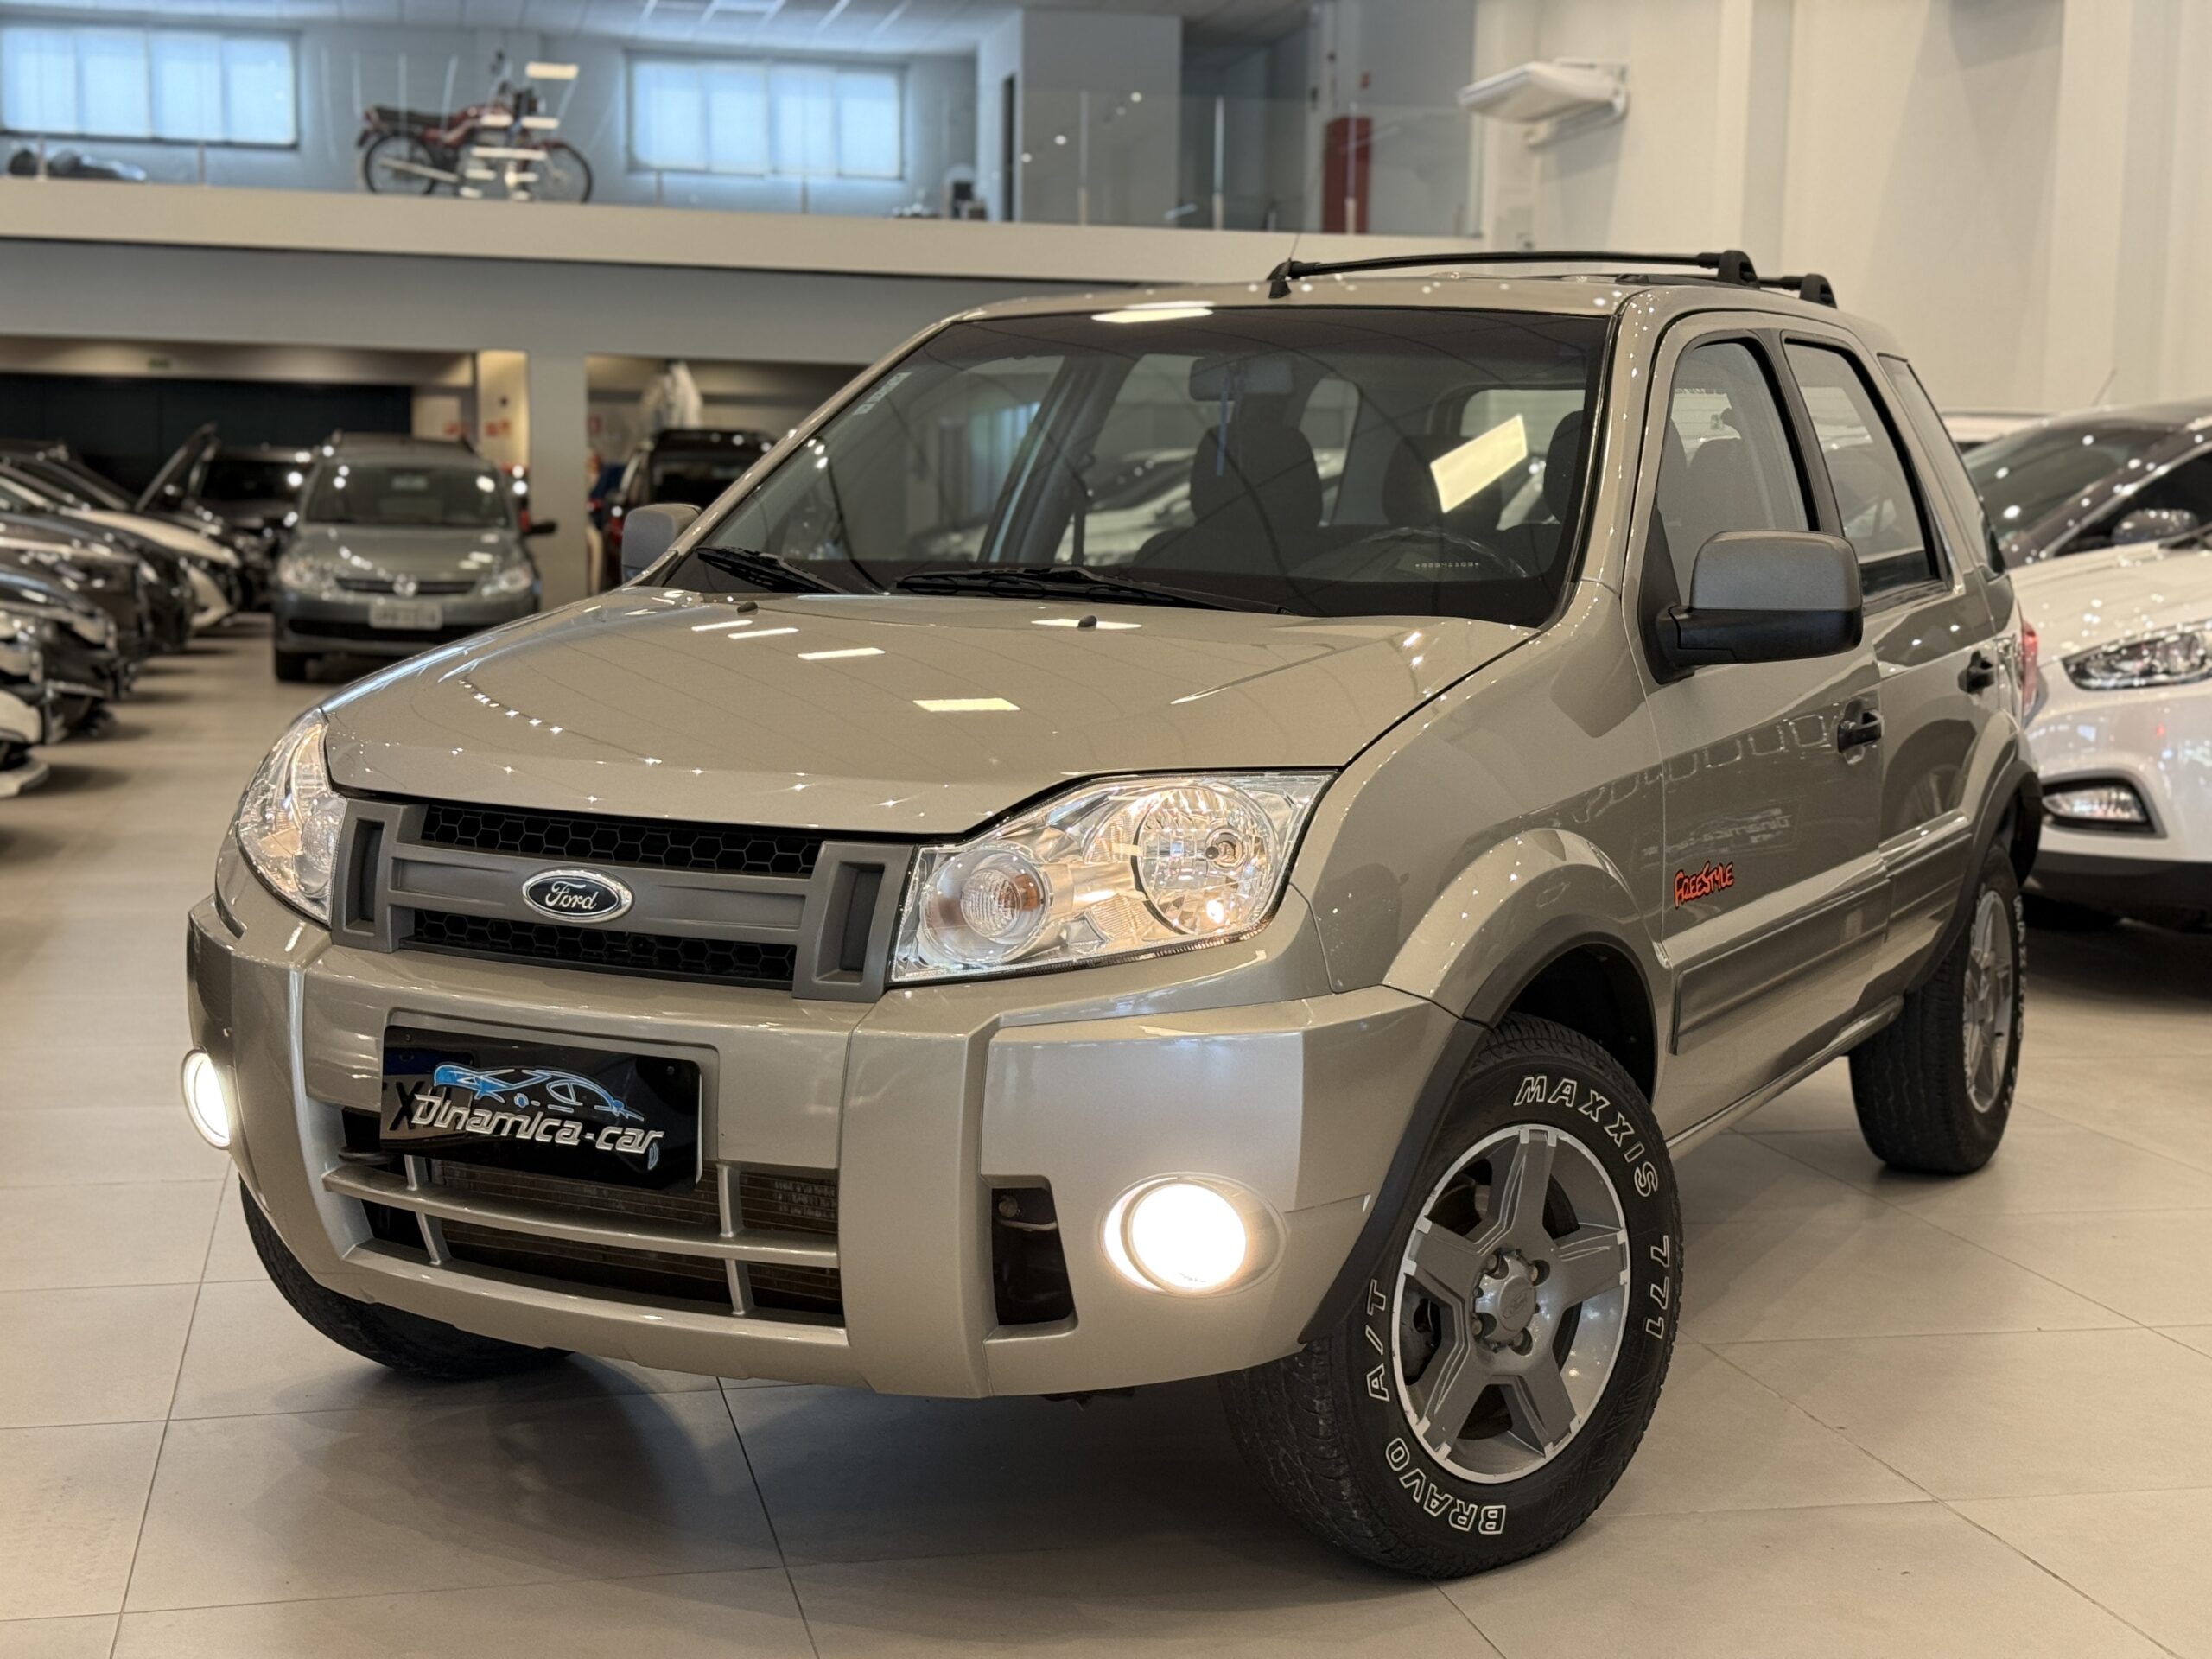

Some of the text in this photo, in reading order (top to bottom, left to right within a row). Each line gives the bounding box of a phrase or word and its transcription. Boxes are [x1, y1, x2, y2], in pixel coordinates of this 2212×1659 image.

[545, 880, 599, 909] Ford
[1513, 1075, 1669, 1339] MAXXIS 771
[1365, 1280, 1506, 1535] BRAVO A/T
